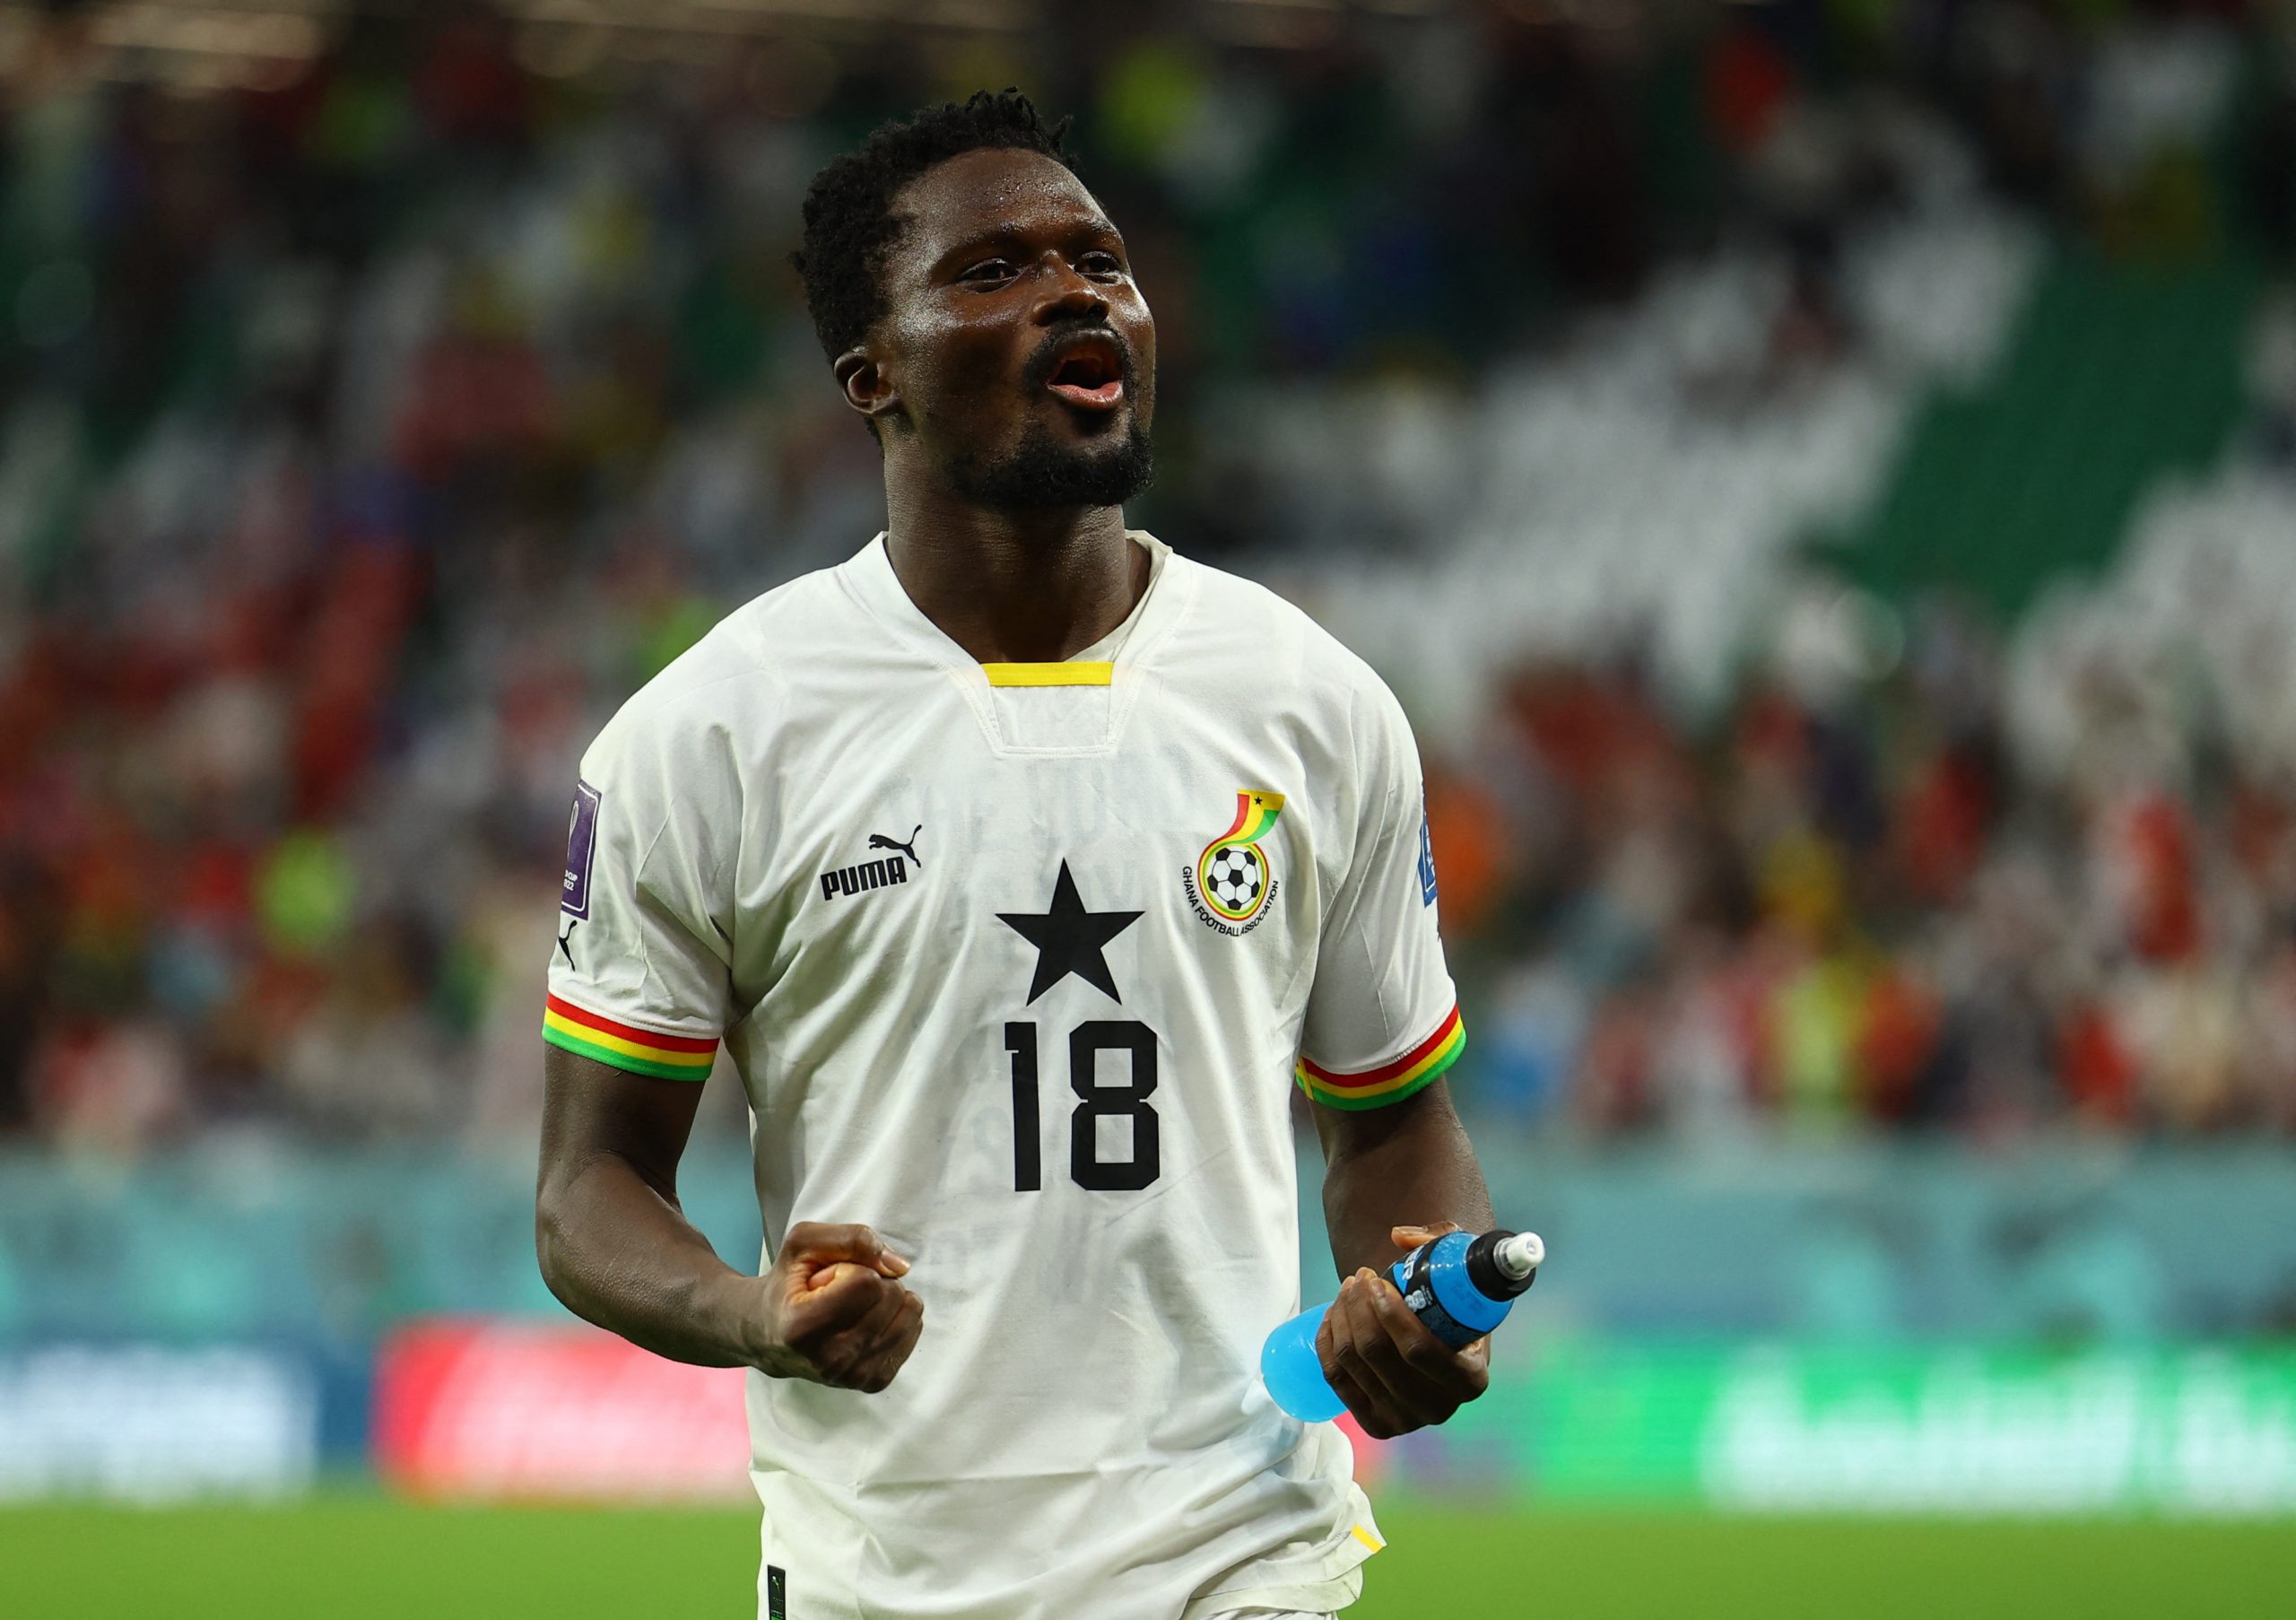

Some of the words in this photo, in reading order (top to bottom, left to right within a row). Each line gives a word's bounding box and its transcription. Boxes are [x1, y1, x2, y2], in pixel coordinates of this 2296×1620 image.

[821, 857, 907, 901] PUMA
[1182, 866, 1199, 908] GHANA
[1195, 906, 1239, 937] FOOTBALL
[1239, 880, 1279, 936] ASSOCIATION
[1004, 1020, 1161, 1192] 18
